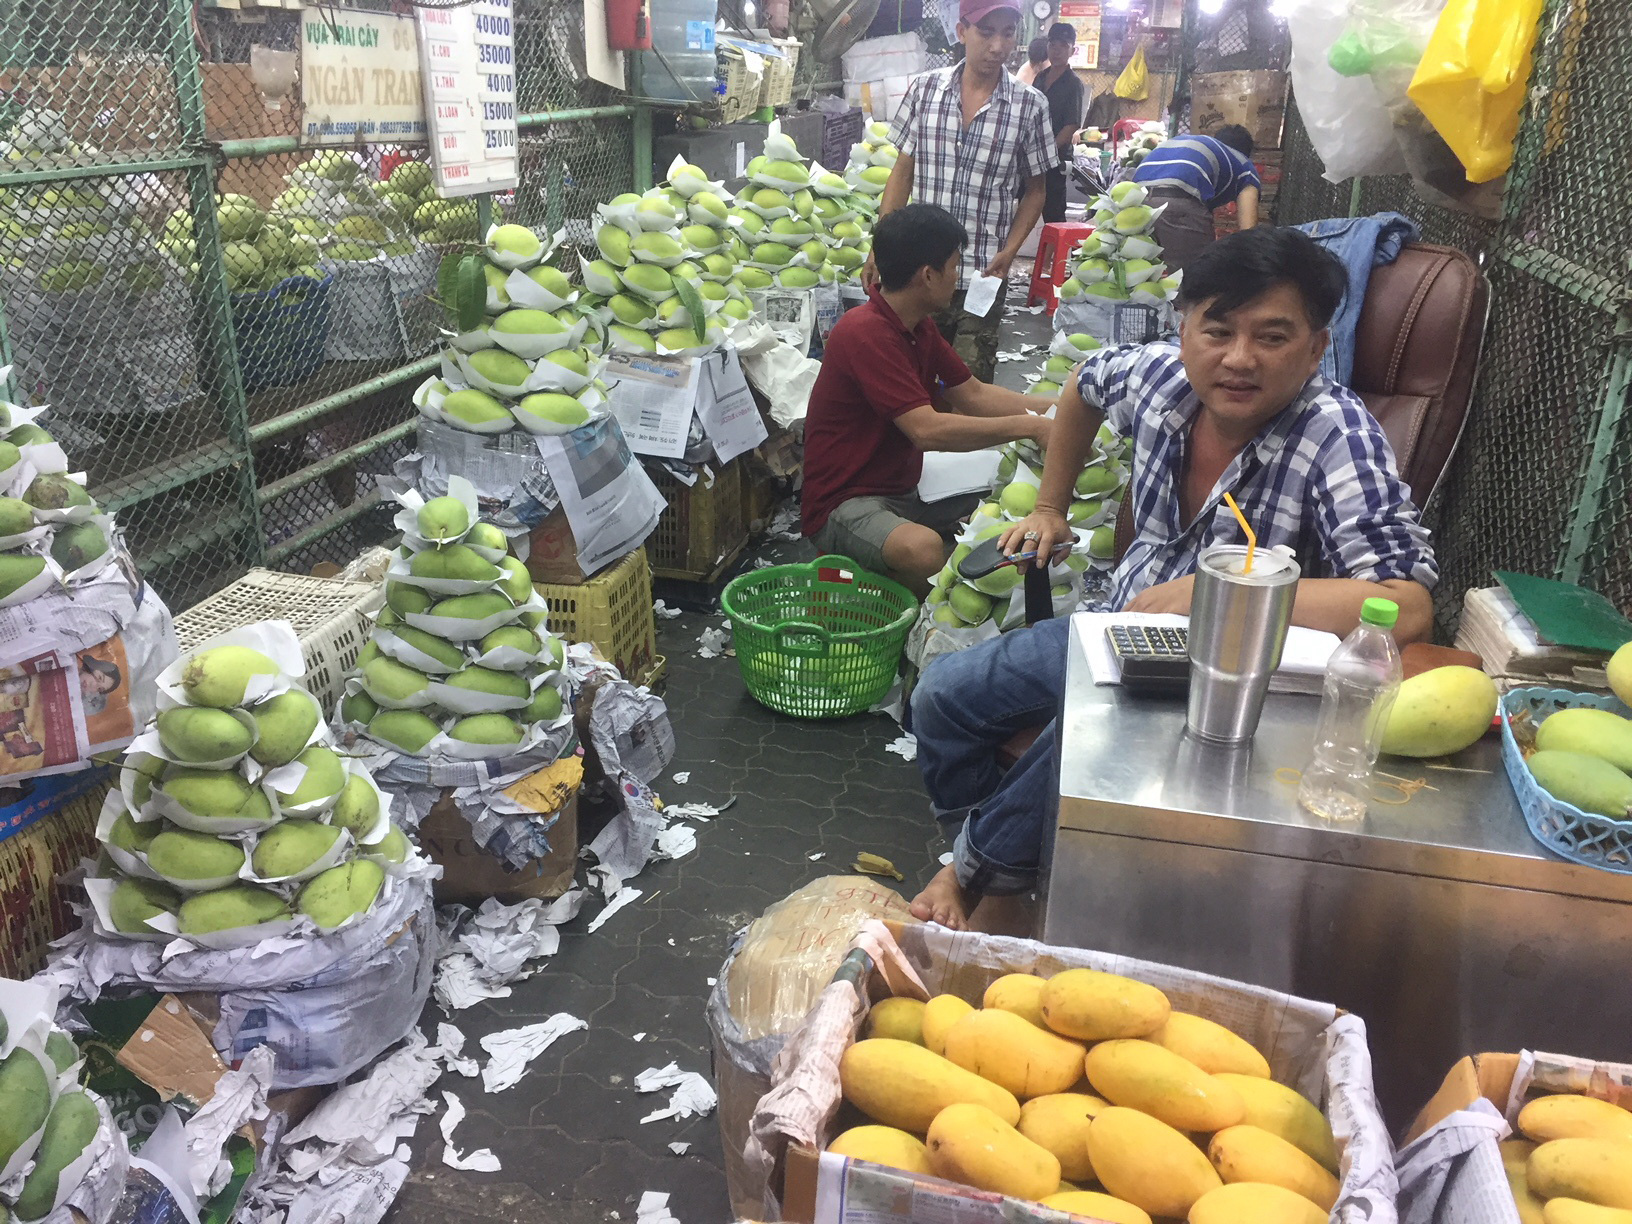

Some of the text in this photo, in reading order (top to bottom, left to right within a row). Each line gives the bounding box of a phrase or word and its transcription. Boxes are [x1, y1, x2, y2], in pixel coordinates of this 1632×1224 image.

[358, 23, 379, 47] CÂY
[476, 14, 510, 36] 40000
[479, 44, 511, 64] 35000
[307, 54, 365, 106] NGÂN
[487, 73, 512, 92] 4000
[484, 102, 513, 120] 15000
[485, 130, 514, 148] 25000
